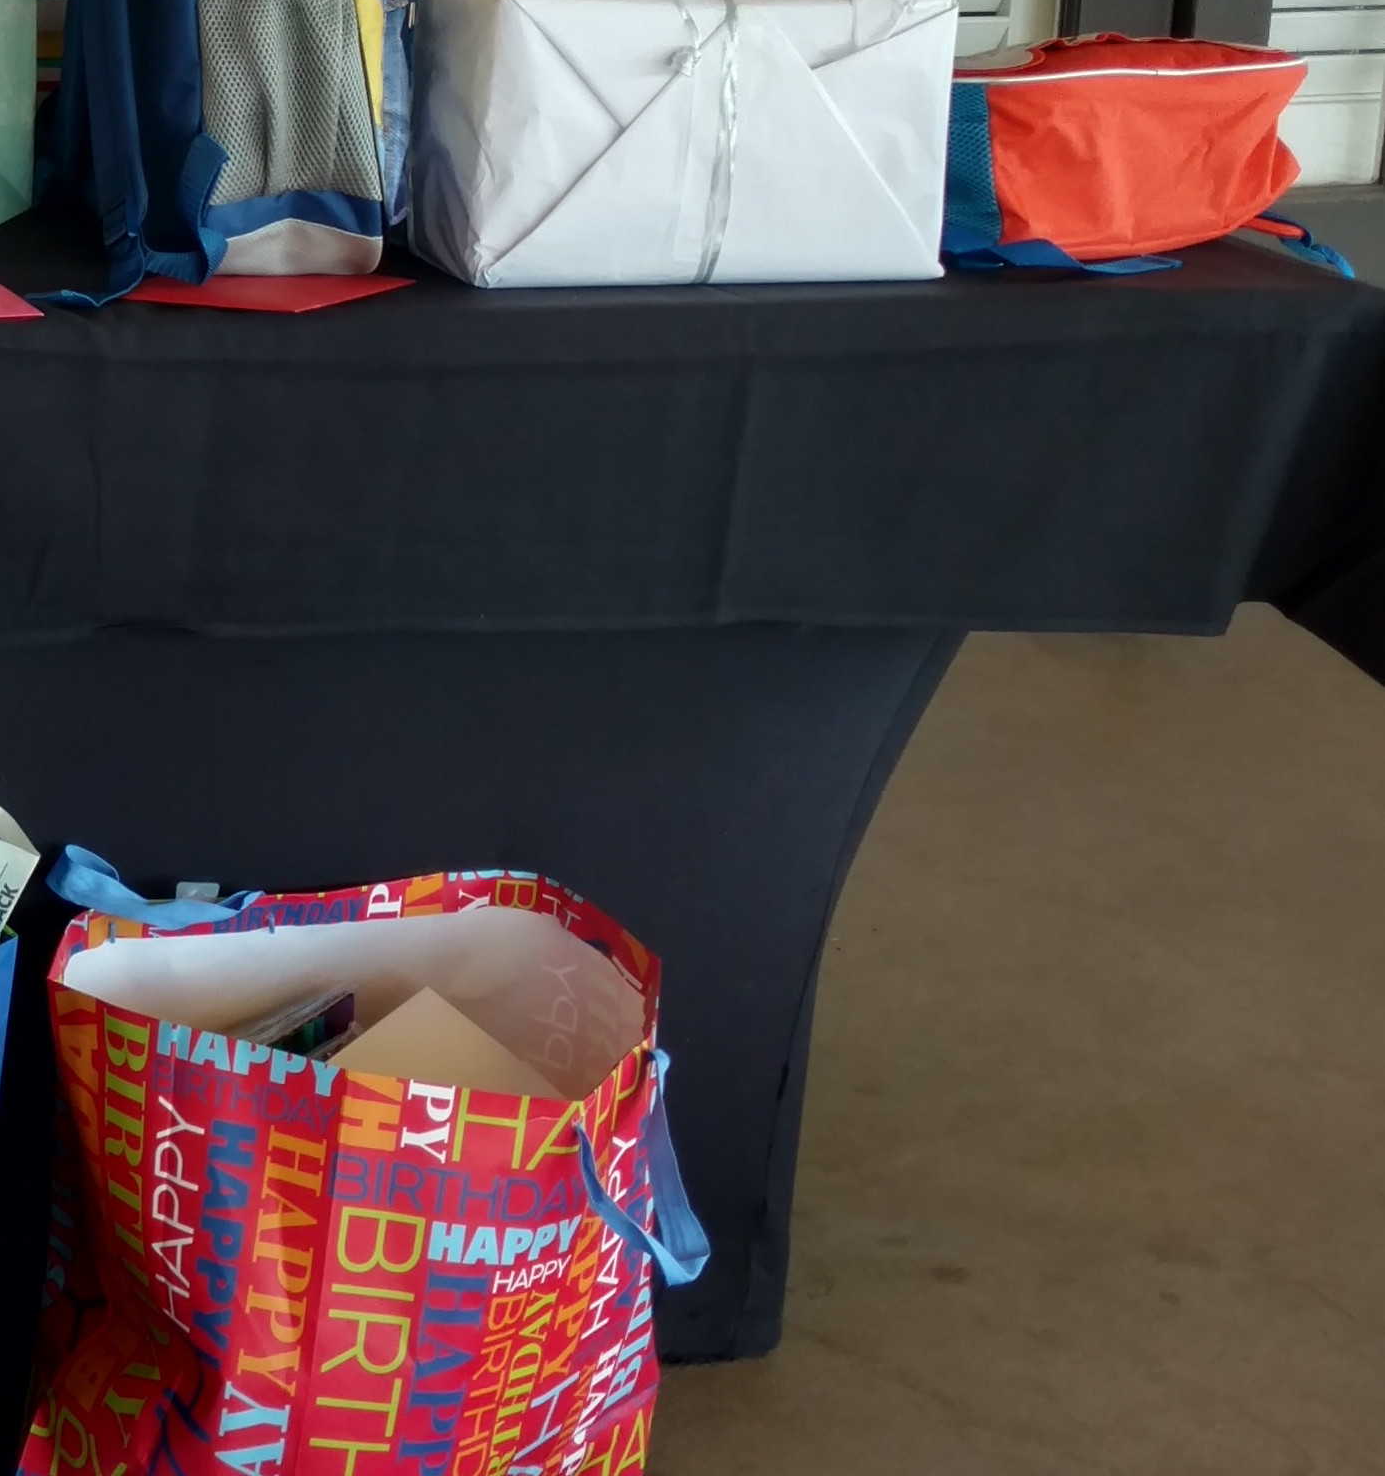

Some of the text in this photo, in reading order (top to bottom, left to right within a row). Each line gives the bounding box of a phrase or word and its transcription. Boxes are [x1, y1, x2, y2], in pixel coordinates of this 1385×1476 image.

[152, 1056, 339, 1136] BIRTHDAY
[156, 1020, 341, 1097] HAPPY
[151, 1095, 206, 1334] HAPPY
[327, 1151, 584, 1224] BIRTHDAY
[191, 1118, 259, 1353] HAPPY
[236, 1124, 328, 1398] HAPPY
[427, 1213, 583, 1266] HAPPY
[491, 1254, 573, 1295] HAPPY
